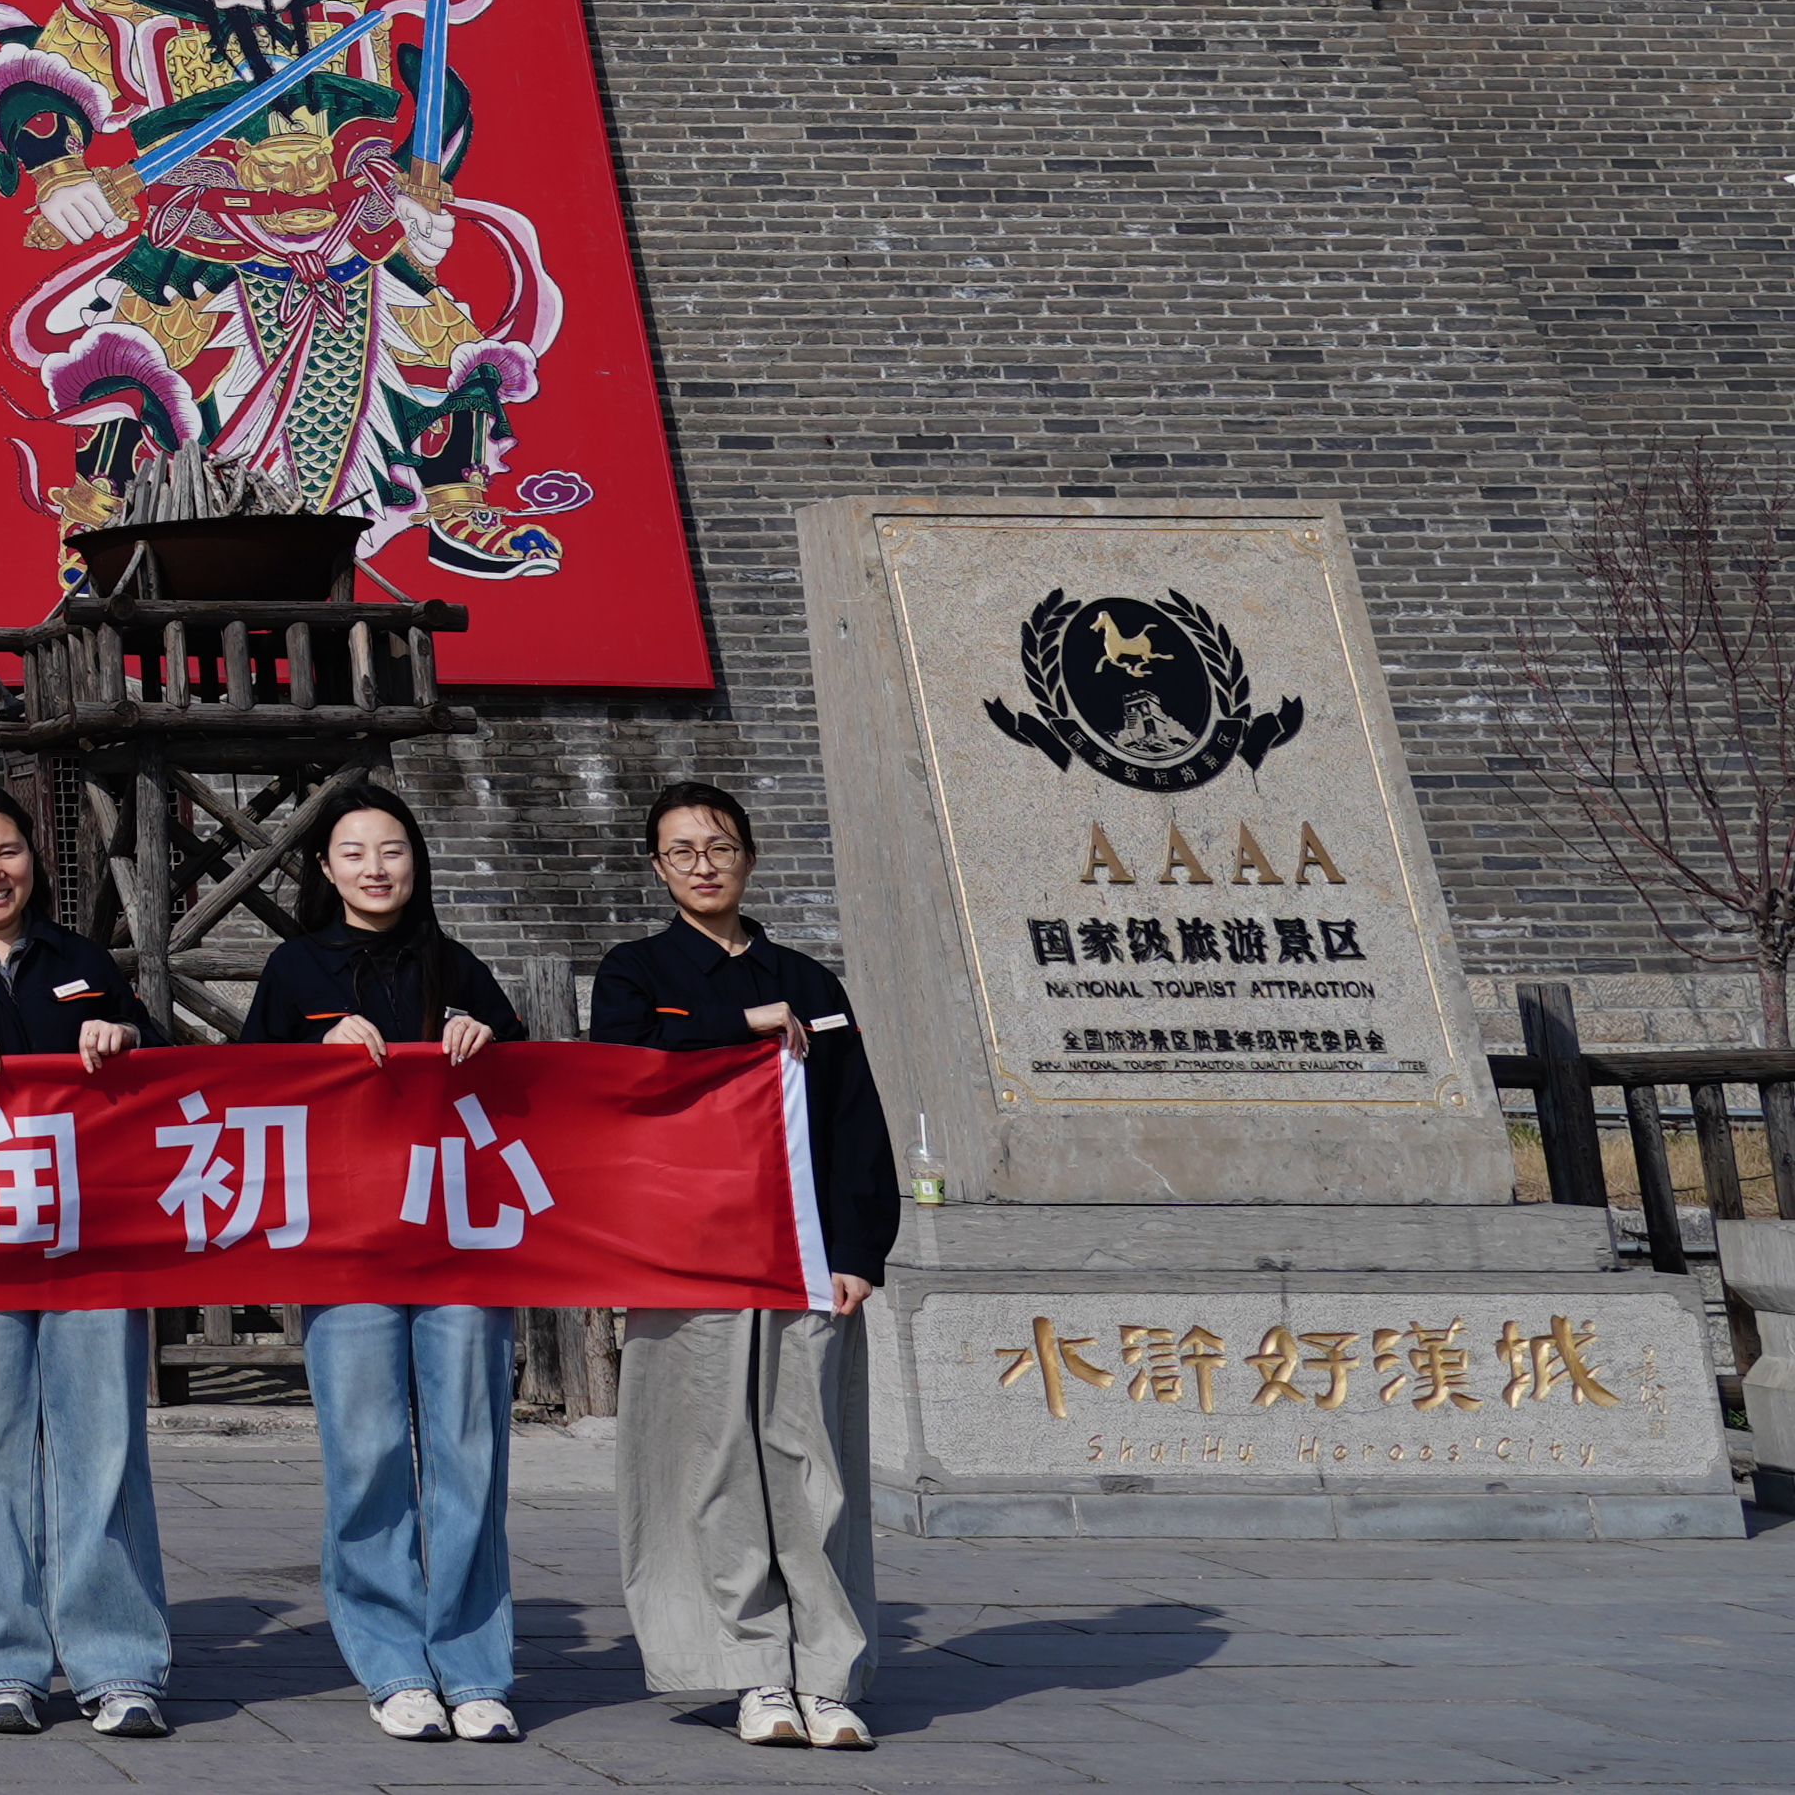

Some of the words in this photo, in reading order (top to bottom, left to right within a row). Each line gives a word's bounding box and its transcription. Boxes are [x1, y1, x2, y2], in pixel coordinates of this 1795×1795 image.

[1027, 917, 1367, 966] 国家级旅游景区
[1045, 980, 1144, 1000] NATIONAL
[1152, 981, 1237, 1000] TOURIST
[1250, 980, 1375, 1000] ATTRACTION
[1062, 1029, 1386, 1053] 全国旅游景区质量等级评定委员会
[1085, 1433, 1256, 1464] ShuiHu
